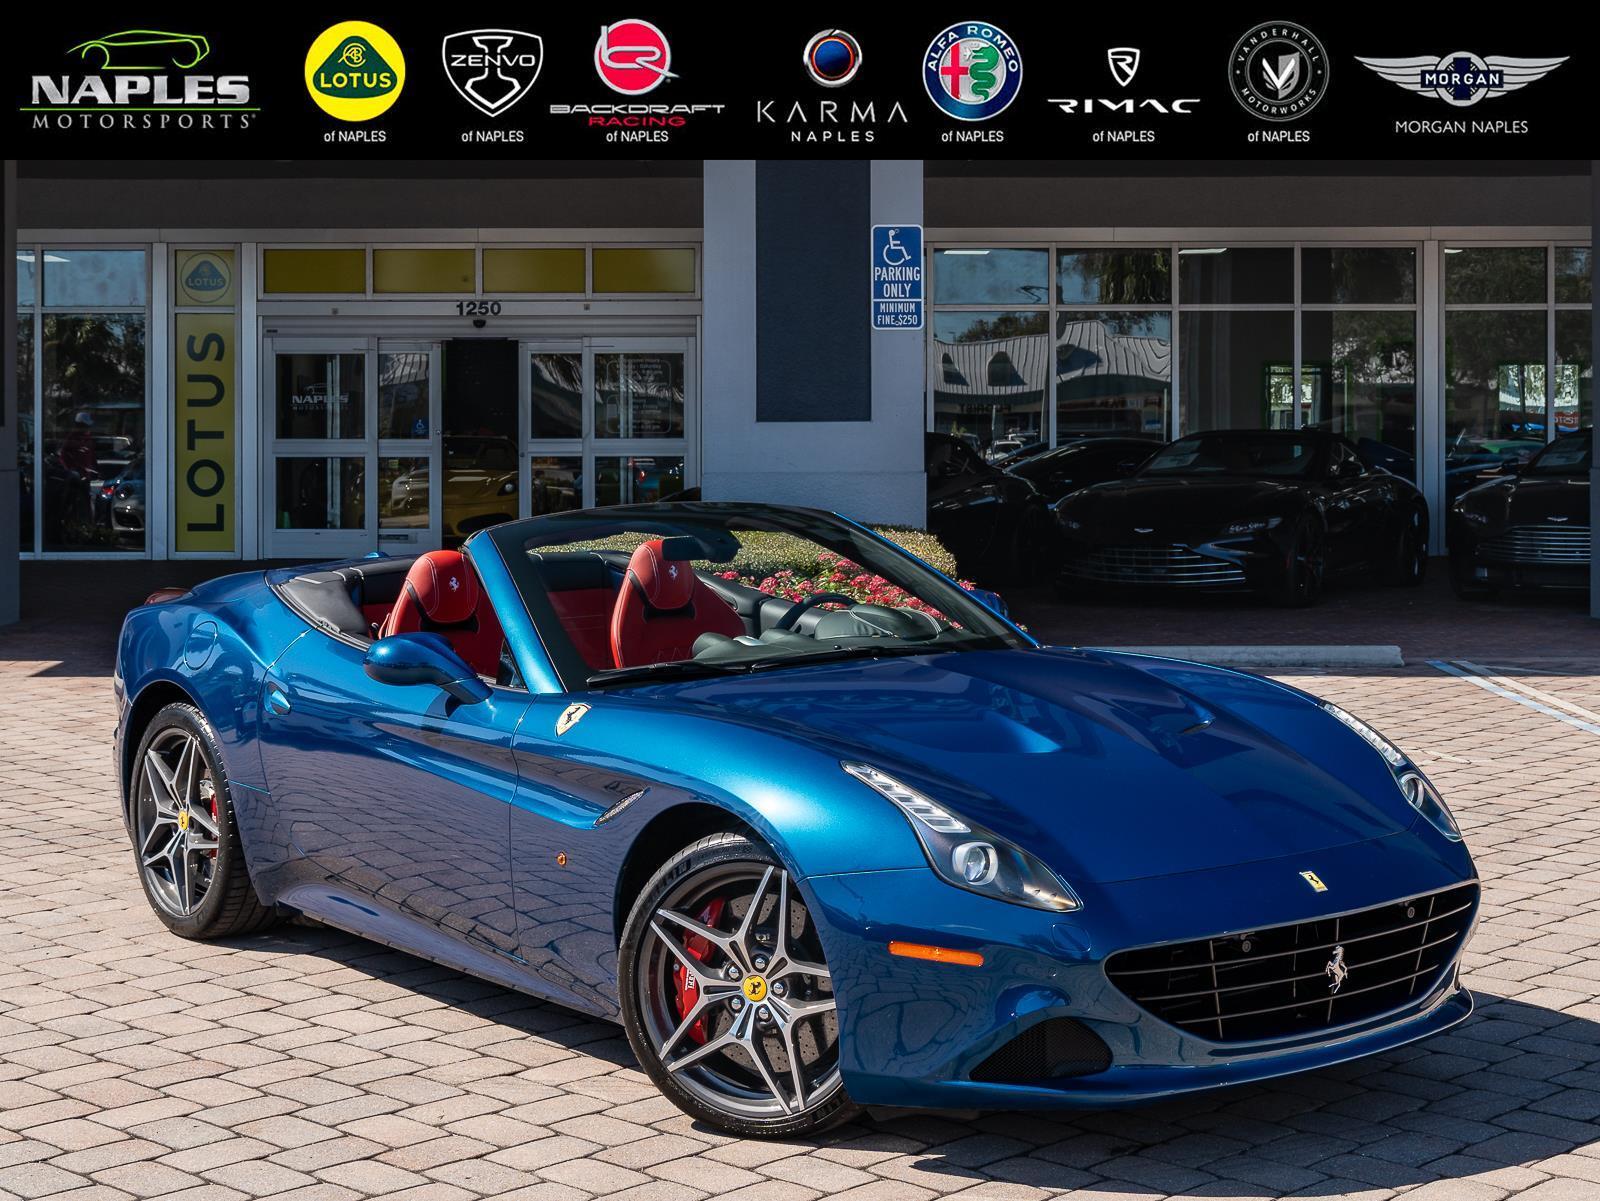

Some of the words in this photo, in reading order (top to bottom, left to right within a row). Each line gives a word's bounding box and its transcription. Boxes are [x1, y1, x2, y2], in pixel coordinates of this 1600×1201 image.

[874, 267, 920, 281] PARKING
[188, 278, 223, 286] LOTUS
[883, 283, 912, 298] ONLY
[456, 301, 502, 316] 1250
[880, 303, 916, 313] MINIMUM
[877, 315, 896, 325] FINE
[899, 315, 918, 325] $250
[186, 332, 226, 532] LOTUS
